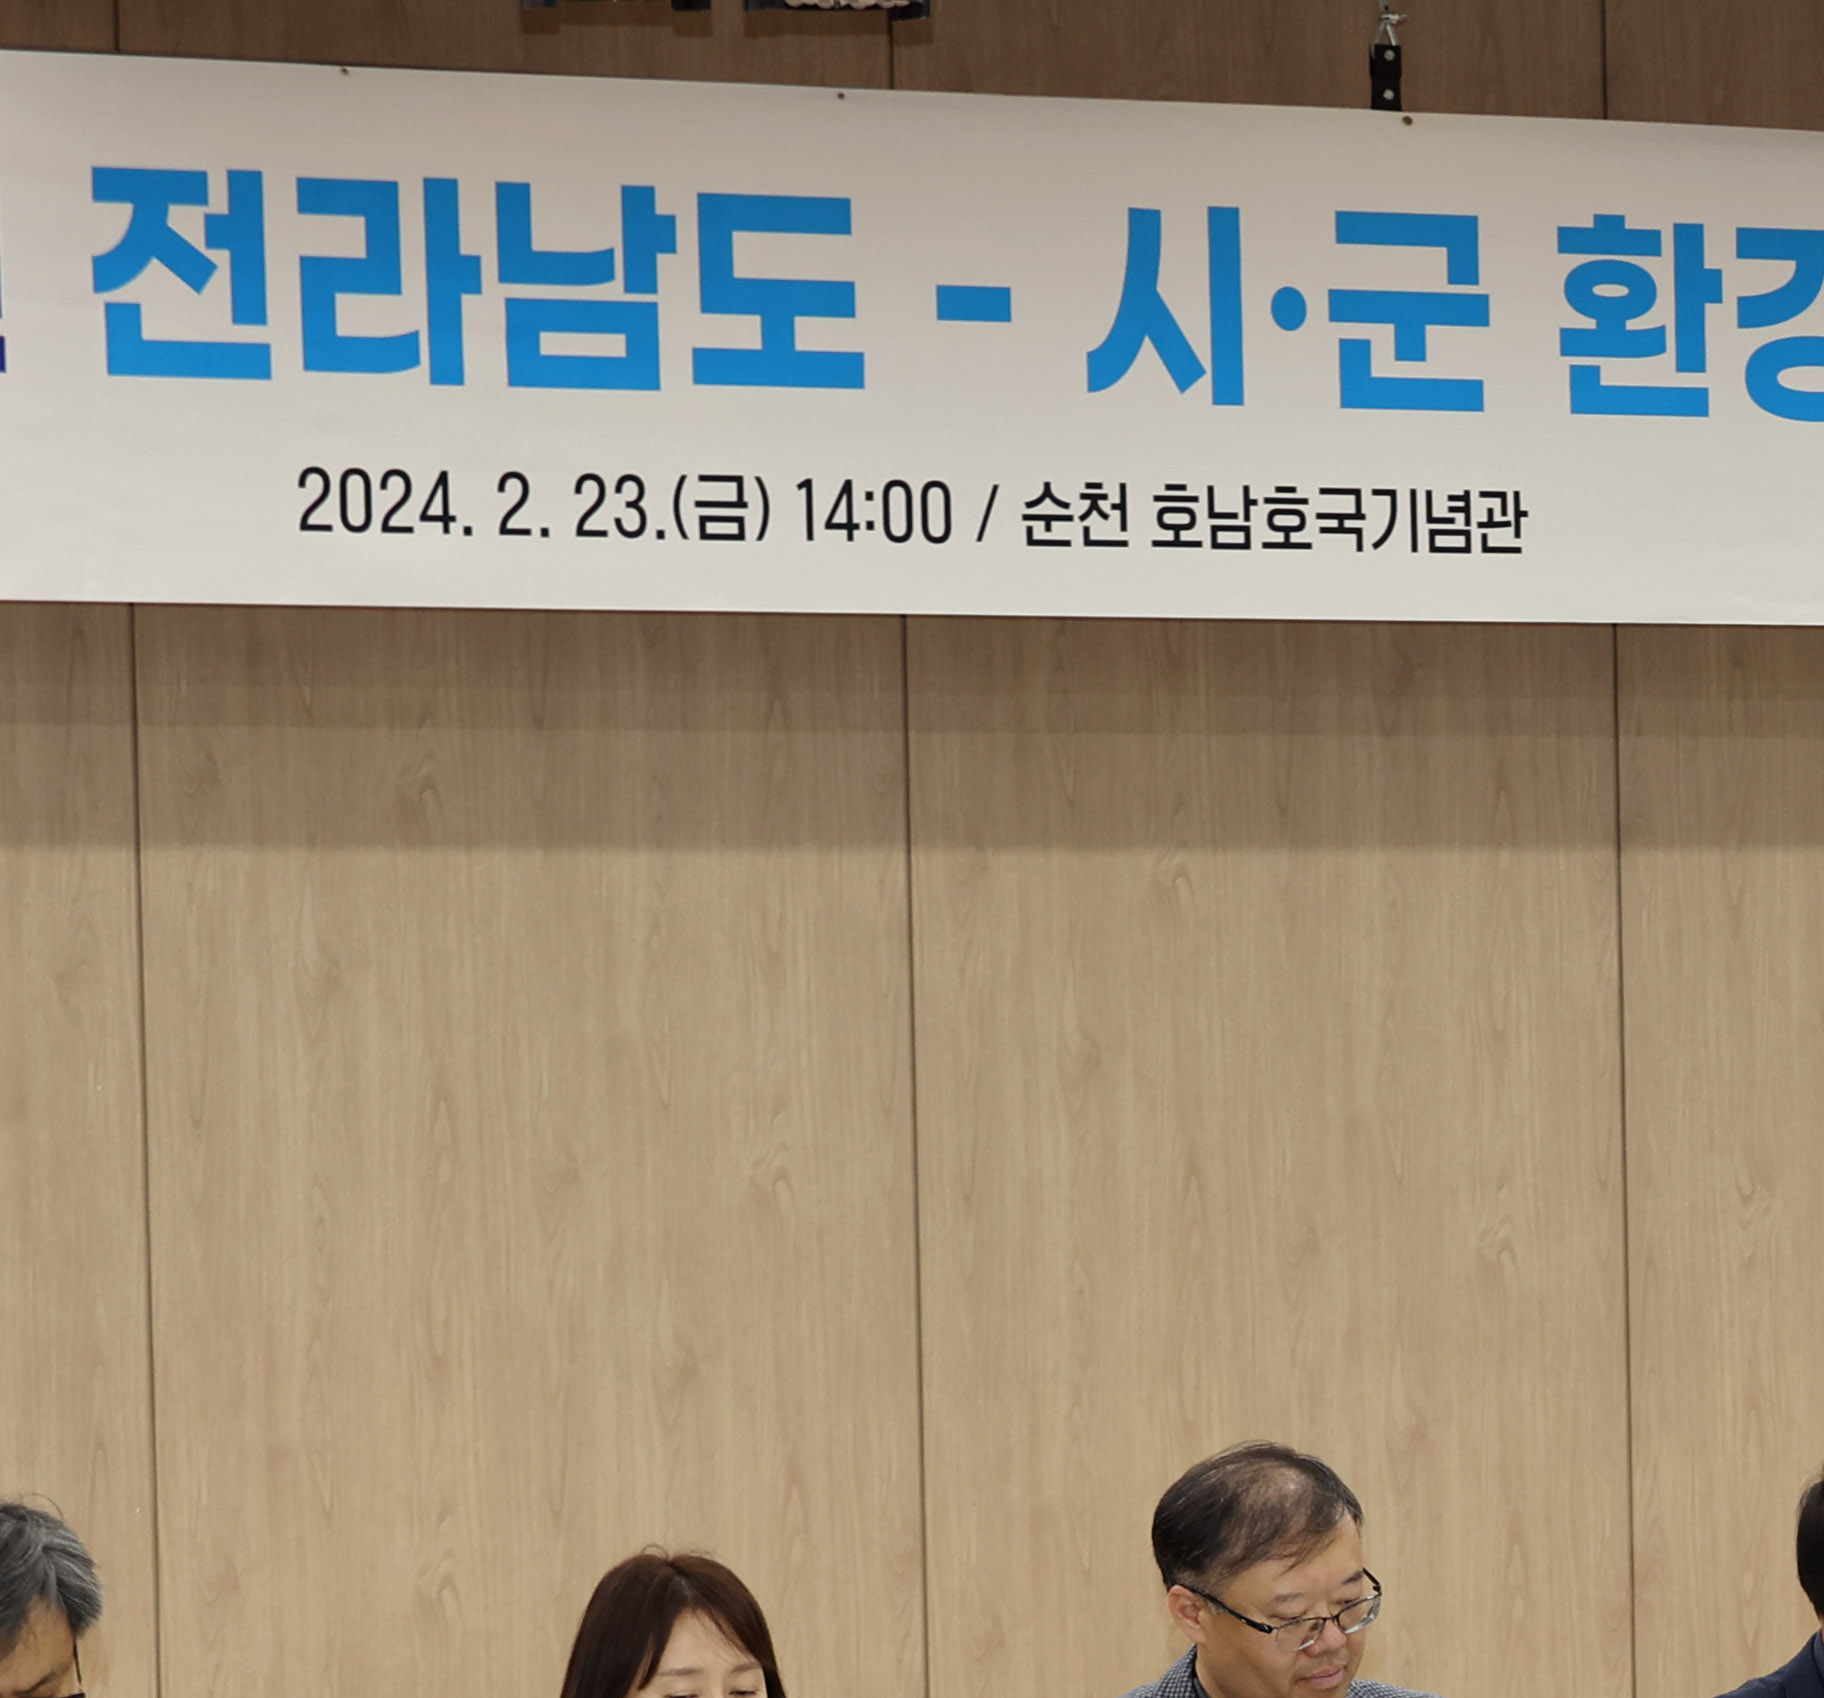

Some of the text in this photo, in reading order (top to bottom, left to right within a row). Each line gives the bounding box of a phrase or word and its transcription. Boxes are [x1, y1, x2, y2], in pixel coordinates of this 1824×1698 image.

[94, 169, 866, 392] 전라남도
[1088, 207, 1491, 413] 시·군
[298, 466, 472, 536] 2024.
[497, 471, 549, 538] 2.
[574, 473, 770, 541] 23.(금)
[797, 478, 952, 544] 14:00
[1022, 481, 1129, 548] 순천
[1151, 483, 1529, 555] 호남호국기념관
